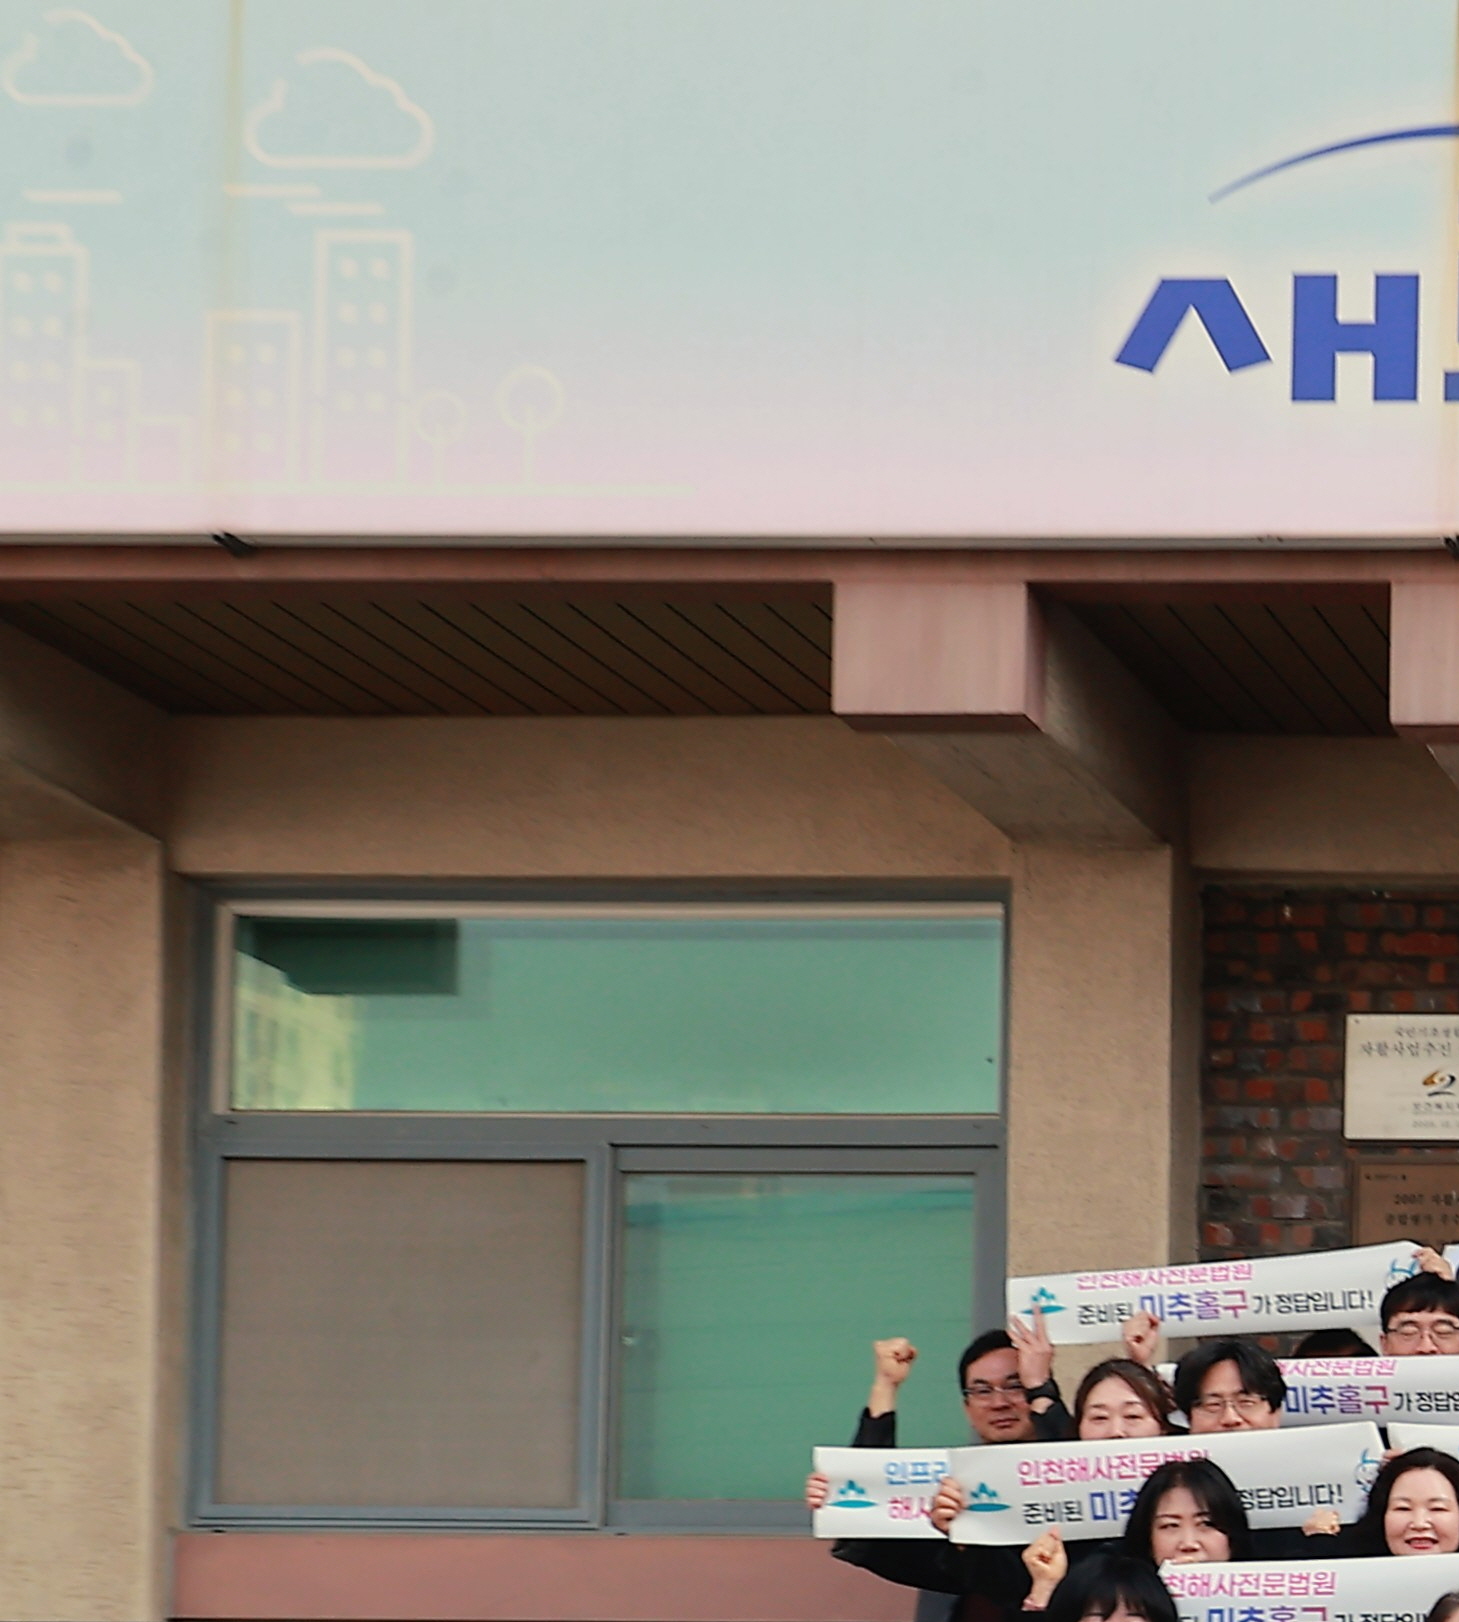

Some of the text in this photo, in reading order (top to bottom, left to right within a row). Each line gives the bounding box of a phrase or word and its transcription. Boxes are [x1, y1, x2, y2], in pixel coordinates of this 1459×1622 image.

[1075, 1264, 1252, 1290] 인천해사전문법원
[1078, 1300, 1130, 1323] 준비된
[1275, 1289, 1372, 1314] 정답입니다!
[1023, 1500, 1083, 1524] 준비된
